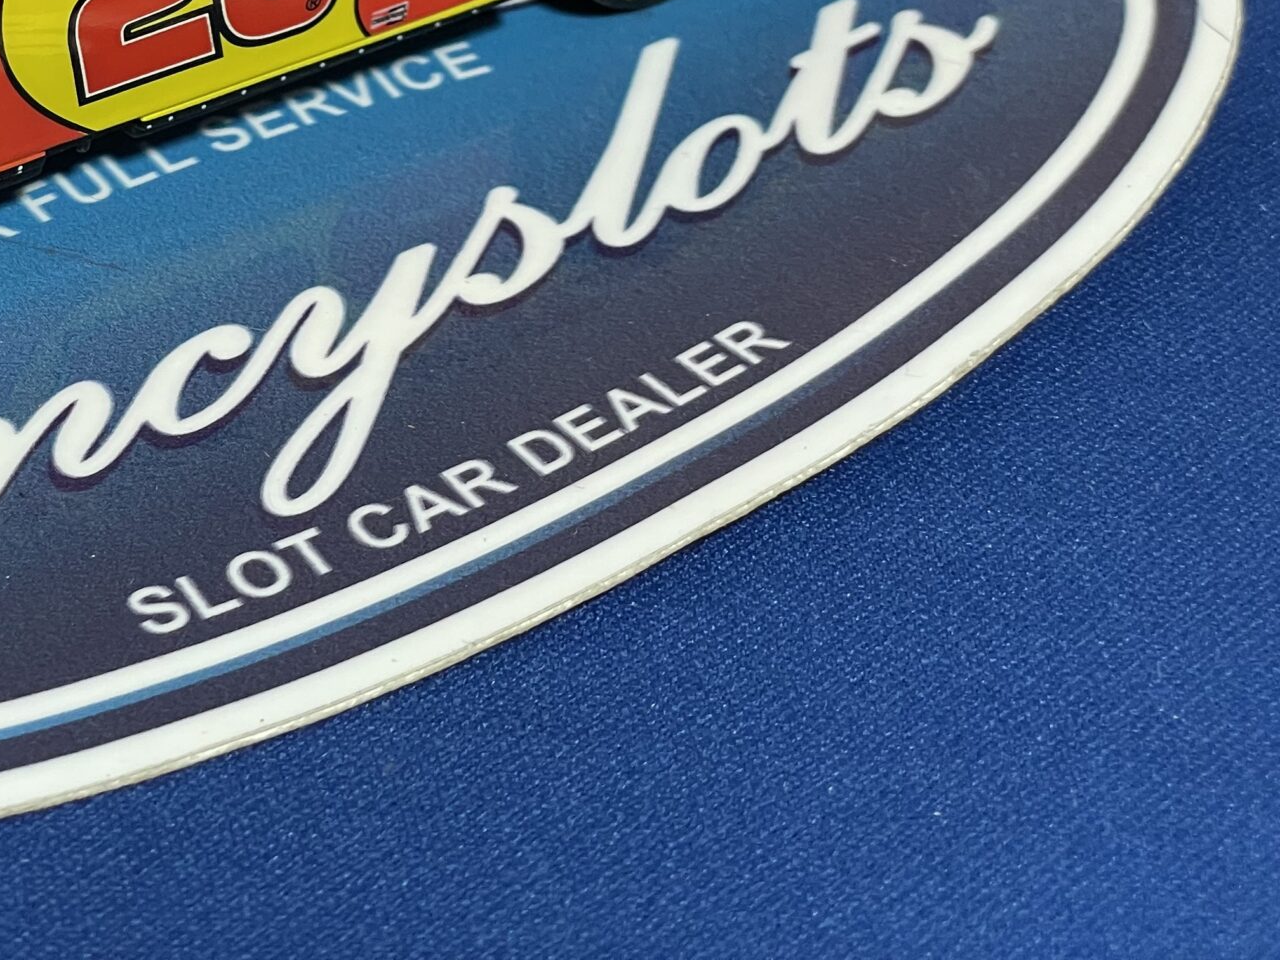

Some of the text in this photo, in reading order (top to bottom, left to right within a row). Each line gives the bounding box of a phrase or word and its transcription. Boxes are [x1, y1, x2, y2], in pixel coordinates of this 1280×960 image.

[20, 146, 200, 223] FULL
[202, 41, 494, 152] SERVICE
[126, 320, 792, 634] SLOT CAR DEALER
